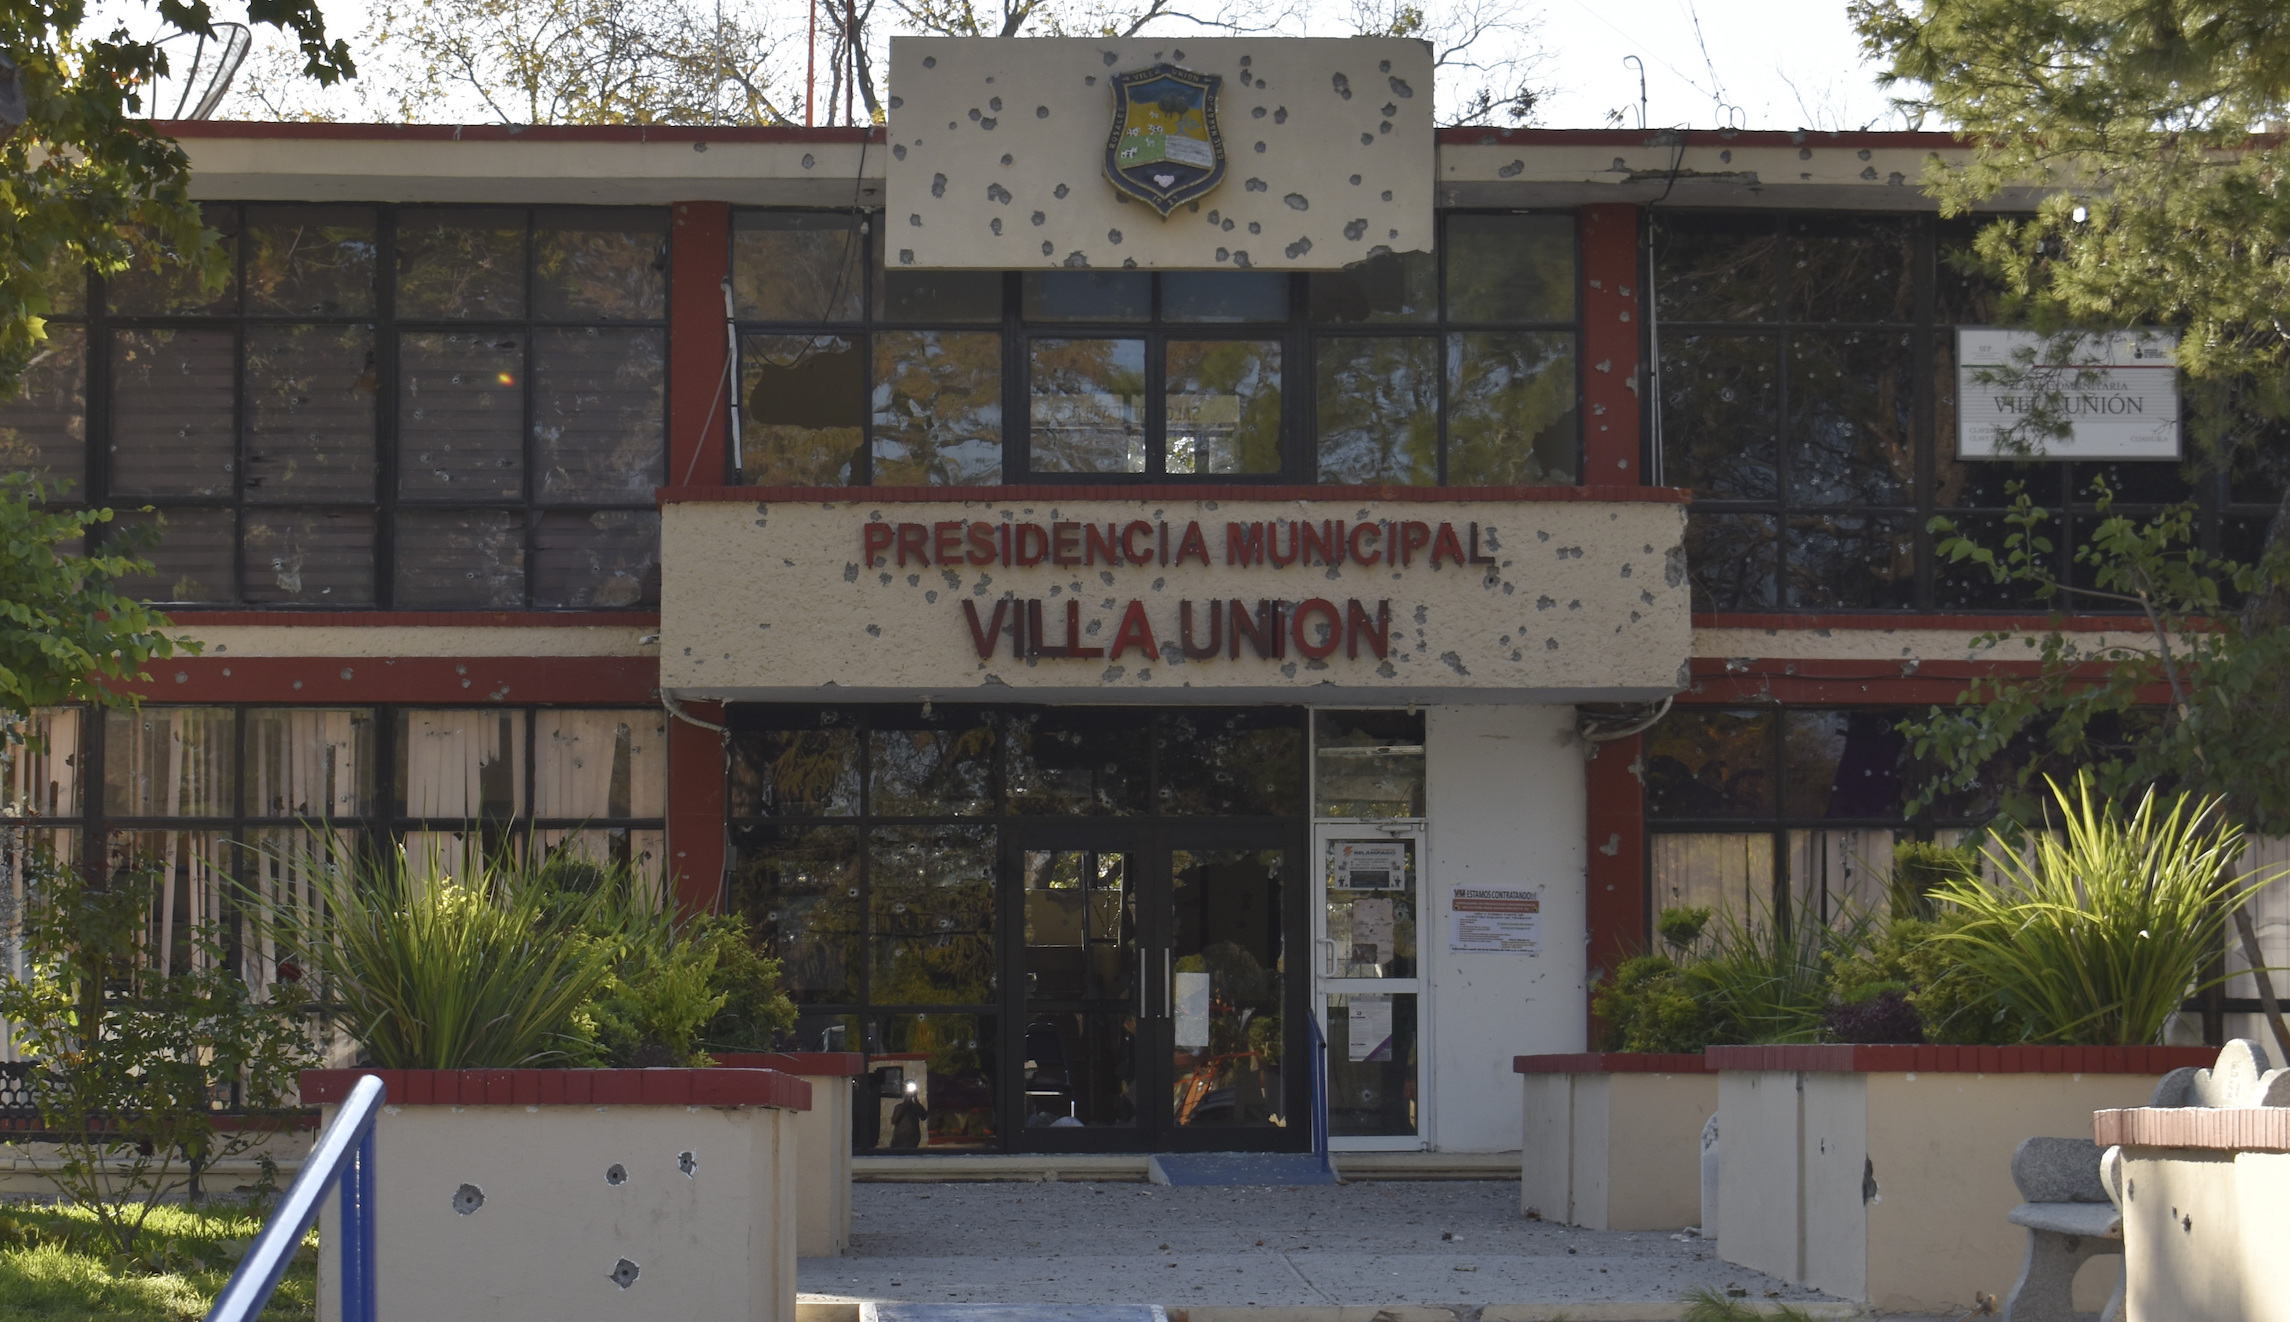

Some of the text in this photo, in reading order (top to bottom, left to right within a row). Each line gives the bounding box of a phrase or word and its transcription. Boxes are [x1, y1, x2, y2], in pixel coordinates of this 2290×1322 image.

[863, 519, 1496, 567] PRESIDENCIA MUNICIPAL
[962, 598, 1389, 660] VILLA UNION
[1466, 890, 1491, 898] ESTAMOS
